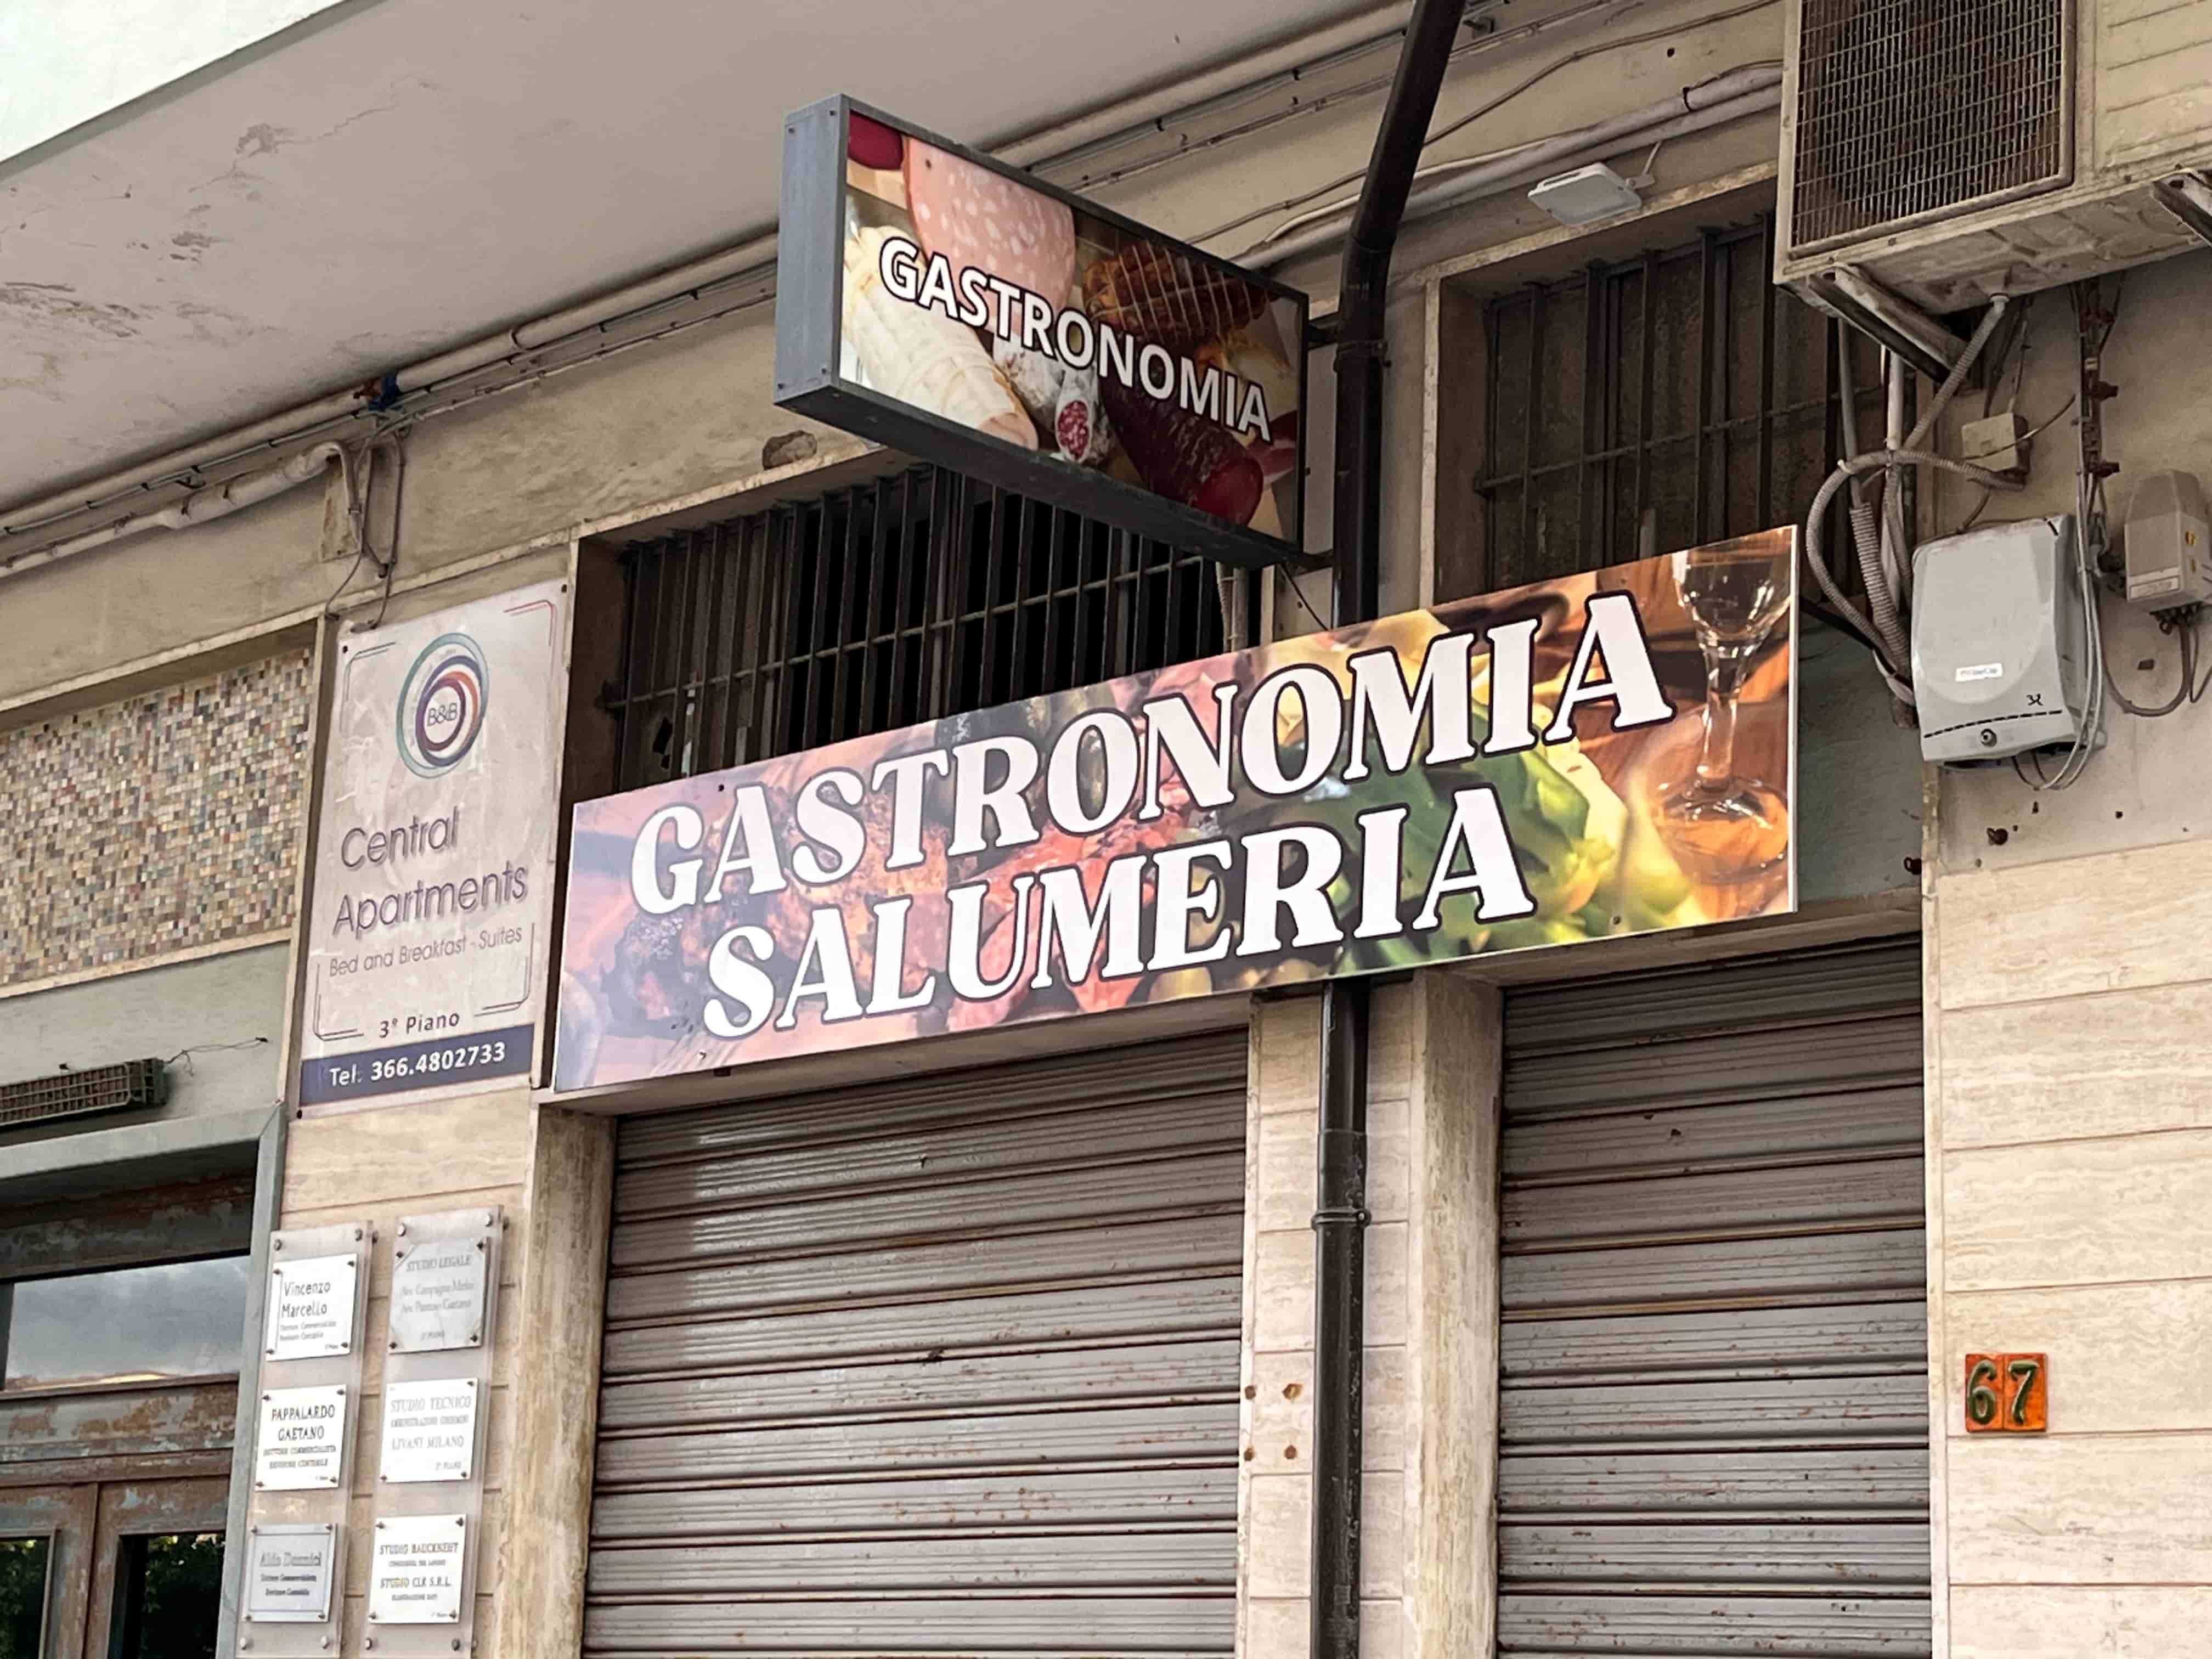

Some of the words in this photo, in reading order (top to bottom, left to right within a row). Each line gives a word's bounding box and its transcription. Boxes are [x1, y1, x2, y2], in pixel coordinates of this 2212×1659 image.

[880, 237, 1271, 442] GASTRONOMIA
[427, 702, 458, 726] B&B
[632, 593, 1672, 914] GASTRONOMIA
[341, 807, 460, 868] Central
[332, 861, 528, 939] Apartments
[702, 788, 1534, 1039] SALUMERIA
[329, 958, 358, 977] Bed
[364, 950, 393, 970] and
[399, 937, 466, 964] Breakfast
[479, 927, 522, 950] Suites
[406, 1013, 460, 1034] Piano
[329, 1065, 362, 1087] Tel.
[371, 1041, 505, 1081] 366.4802733
[282, 1300, 327, 1317] Marcello
[284, 1282, 331, 1296] Vincenzo
[1967, 1359, 2040, 1425] 67
[278, 1425, 324, 1441] GAETANO
